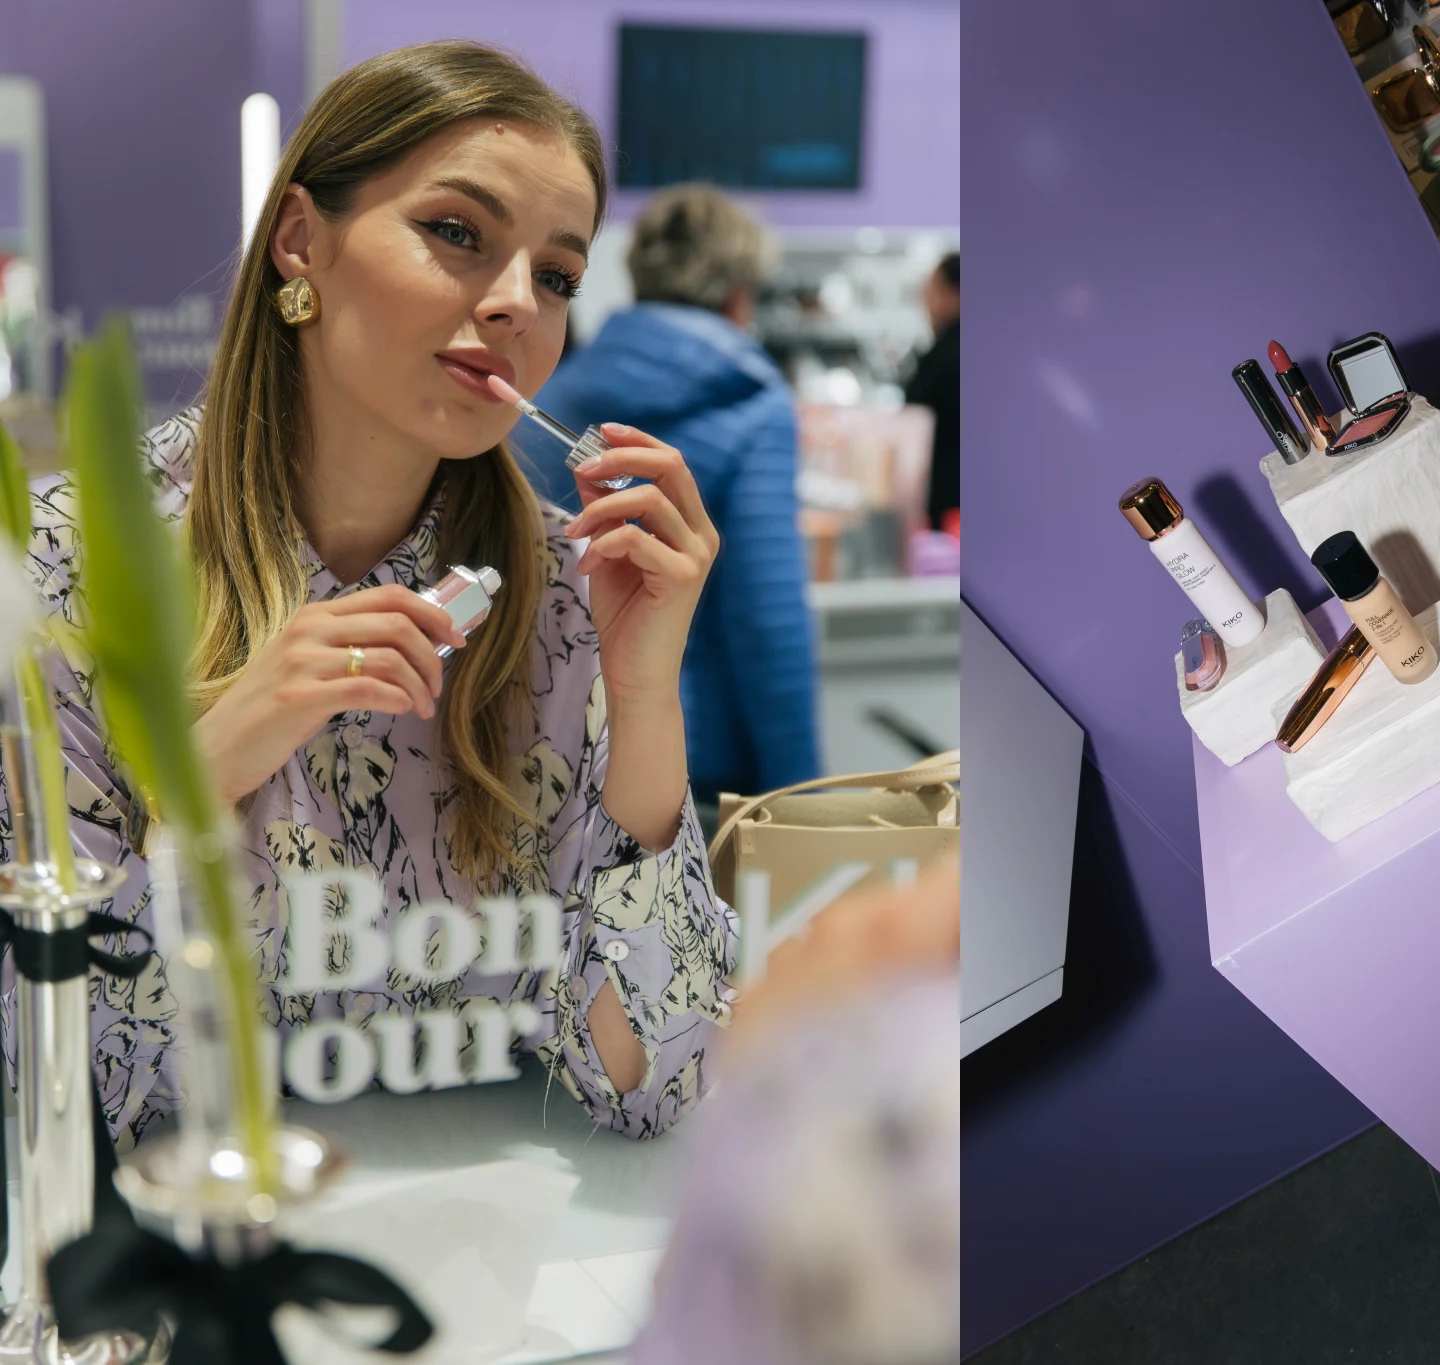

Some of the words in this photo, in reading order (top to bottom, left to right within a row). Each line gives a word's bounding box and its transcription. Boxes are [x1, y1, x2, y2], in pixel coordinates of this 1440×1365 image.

[1343, 442, 1358, 450] KIKO
[1165, 552, 1190, 568] HYDRA
[1170, 563, 1186, 573] PRO
[1175, 565, 1196, 580] GLOW
[1221, 611, 1243, 628] KIKO
[1400, 645, 1425, 668] KIKO
[279, 869, 566, 991] Bon
